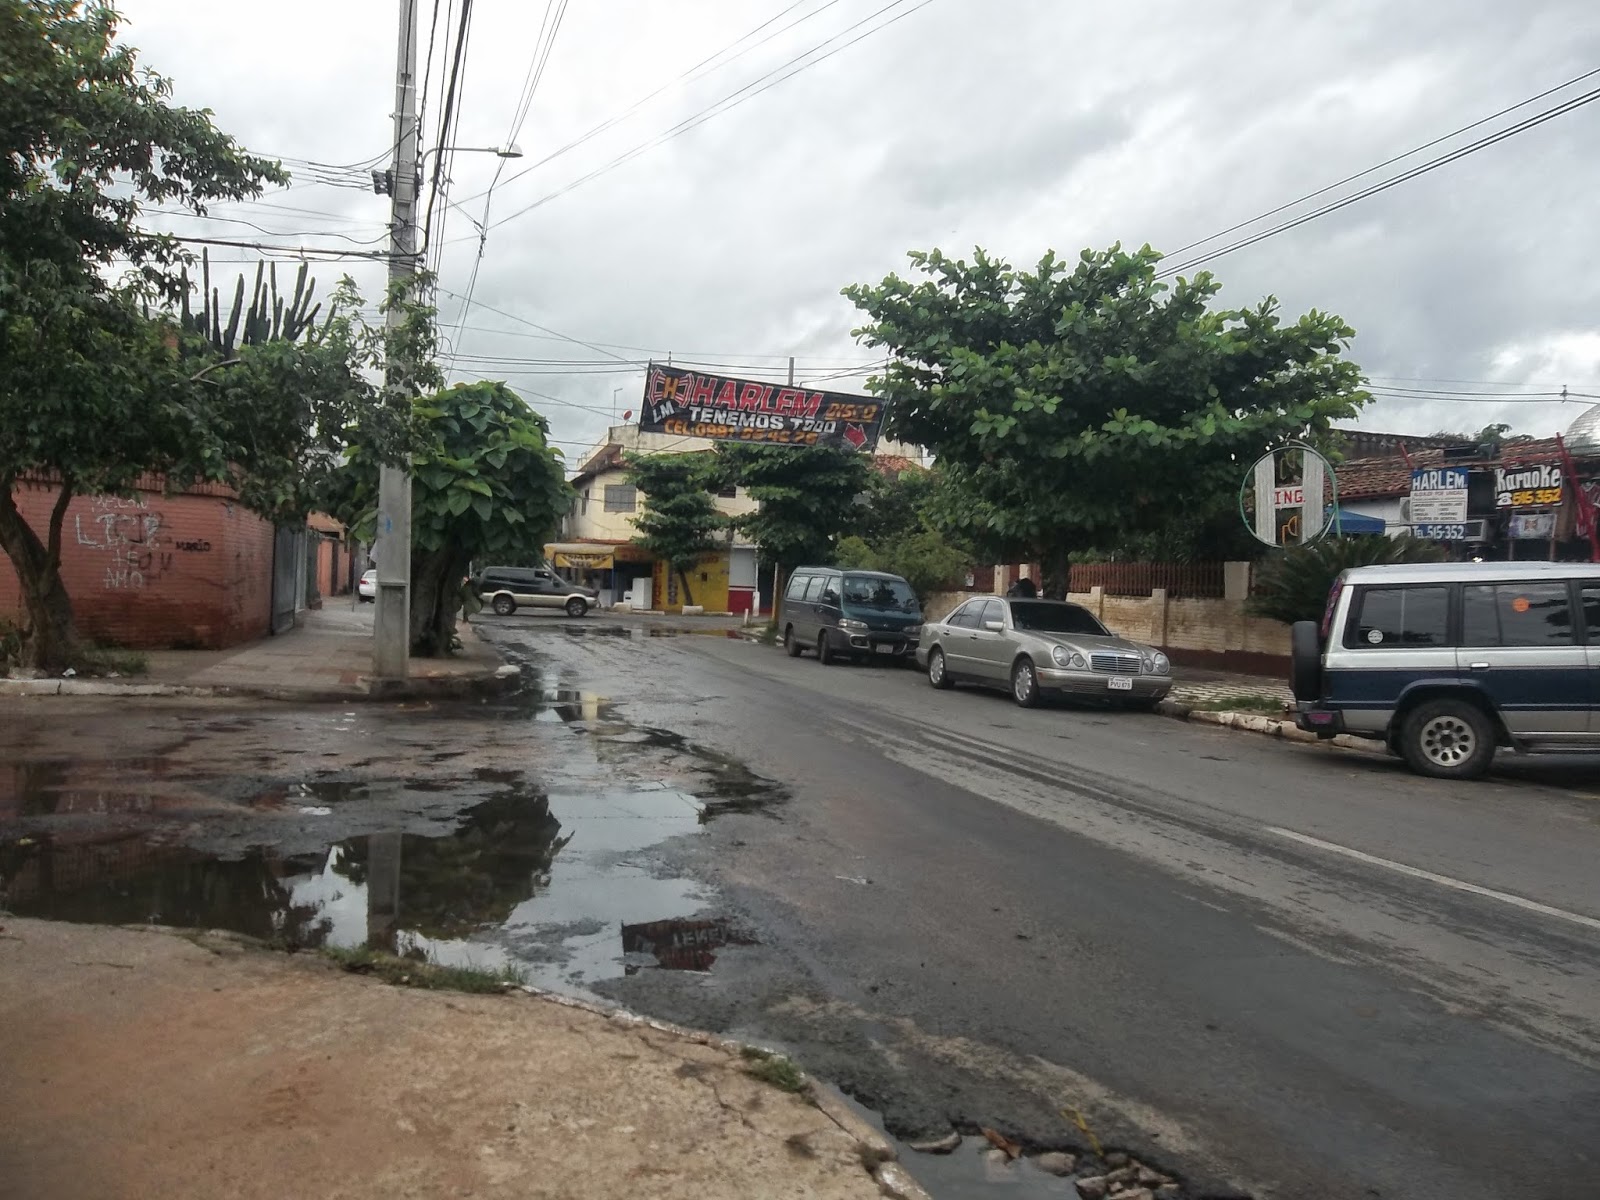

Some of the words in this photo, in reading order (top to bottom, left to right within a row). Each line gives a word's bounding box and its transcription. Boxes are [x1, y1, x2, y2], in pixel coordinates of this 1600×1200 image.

[690, 376, 824, 418] HARLEM
[689, 407, 784, 430] TENEMOS
[790, 417, 836, 434] TODO
[1512, 491, 1534, 505] 515
[1535, 488, 1561, 503] 352
[1427, 525, 1464, 540] 515-352
